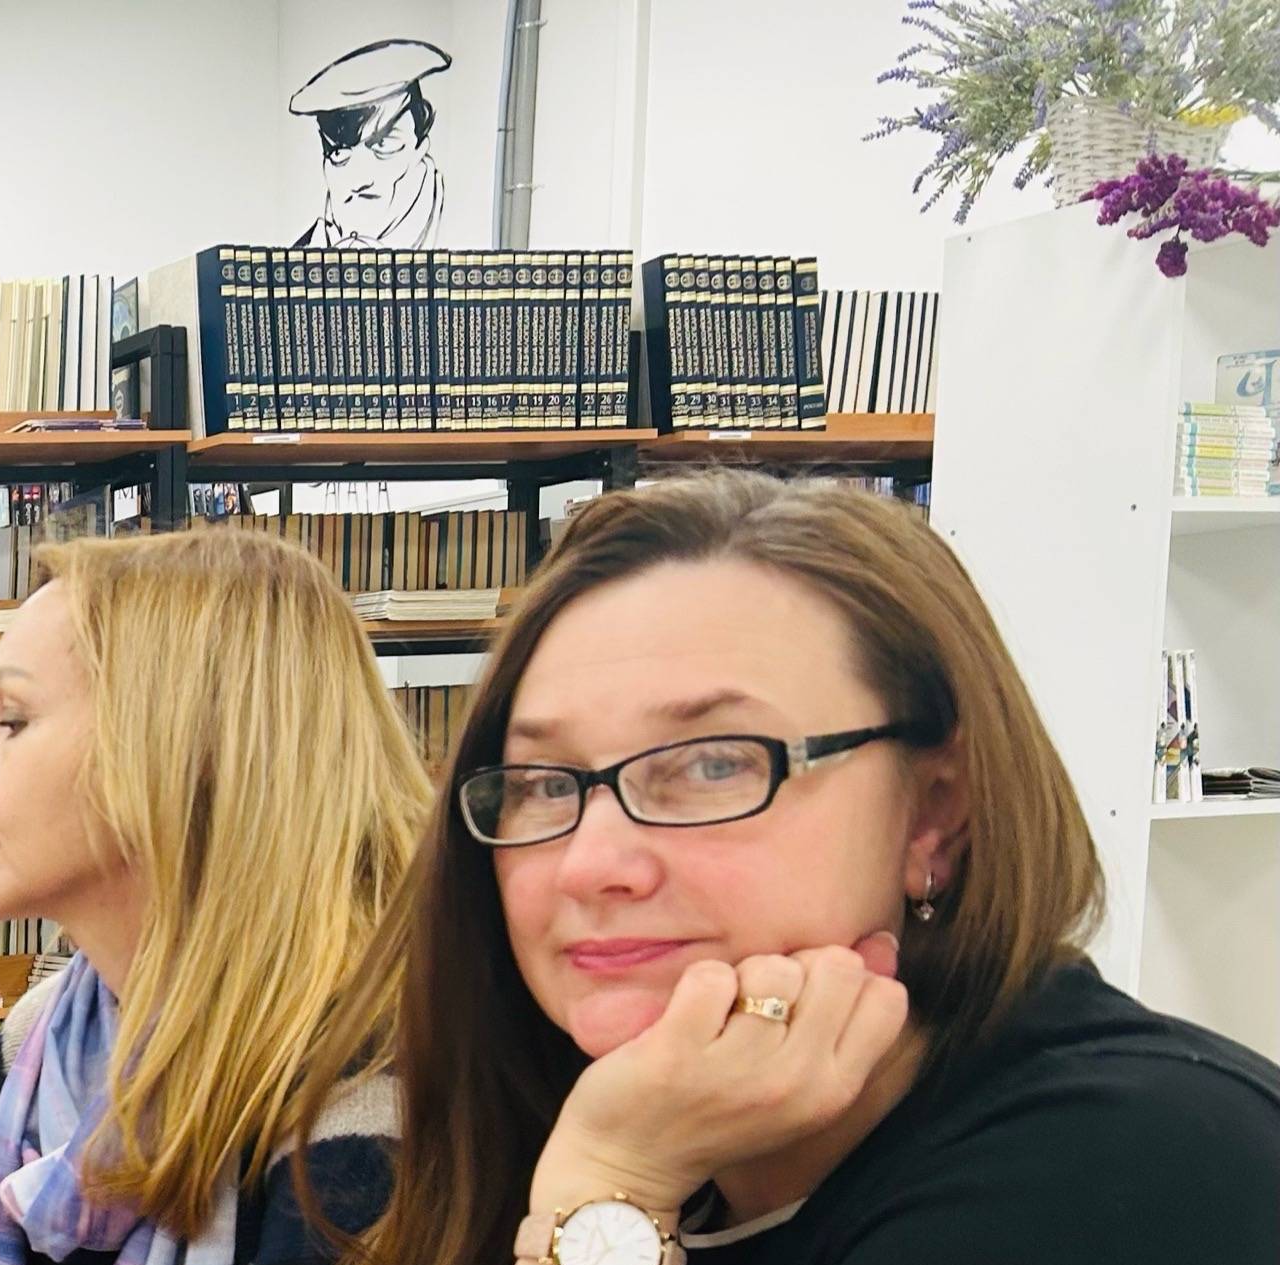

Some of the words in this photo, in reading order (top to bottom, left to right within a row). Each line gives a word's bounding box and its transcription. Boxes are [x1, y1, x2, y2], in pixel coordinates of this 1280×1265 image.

[235, 395, 239, 405] 1
[251, 396, 256, 406] 2
[286, 396, 291, 405] 4
[304, 396, 308, 405] 5
[321, 397, 326, 406] 6
[338, 397, 344, 406] 7
[355, 397, 360, 406] 8
[373, 397, 378, 406] 9
[442, 396, 450, 406] 13
[472, 397, 480, 406] 15
[488, 397, 497, 406] 16
[502, 396, 510, 405] 17
[518, 396, 527, 404] 18
[533, 396, 542, 405] 19
[548, 396, 559, 405] 20
[584, 394, 594, 404] 25
[602, 394, 611, 404] 26
[616, 394, 626, 404] 27
[674, 394, 685, 405] 28
[707, 394, 716, 404] 30
[721, 397, 730, 406] 31
[736, 396, 746, 405] 32
[768, 396, 777, 406] 34
